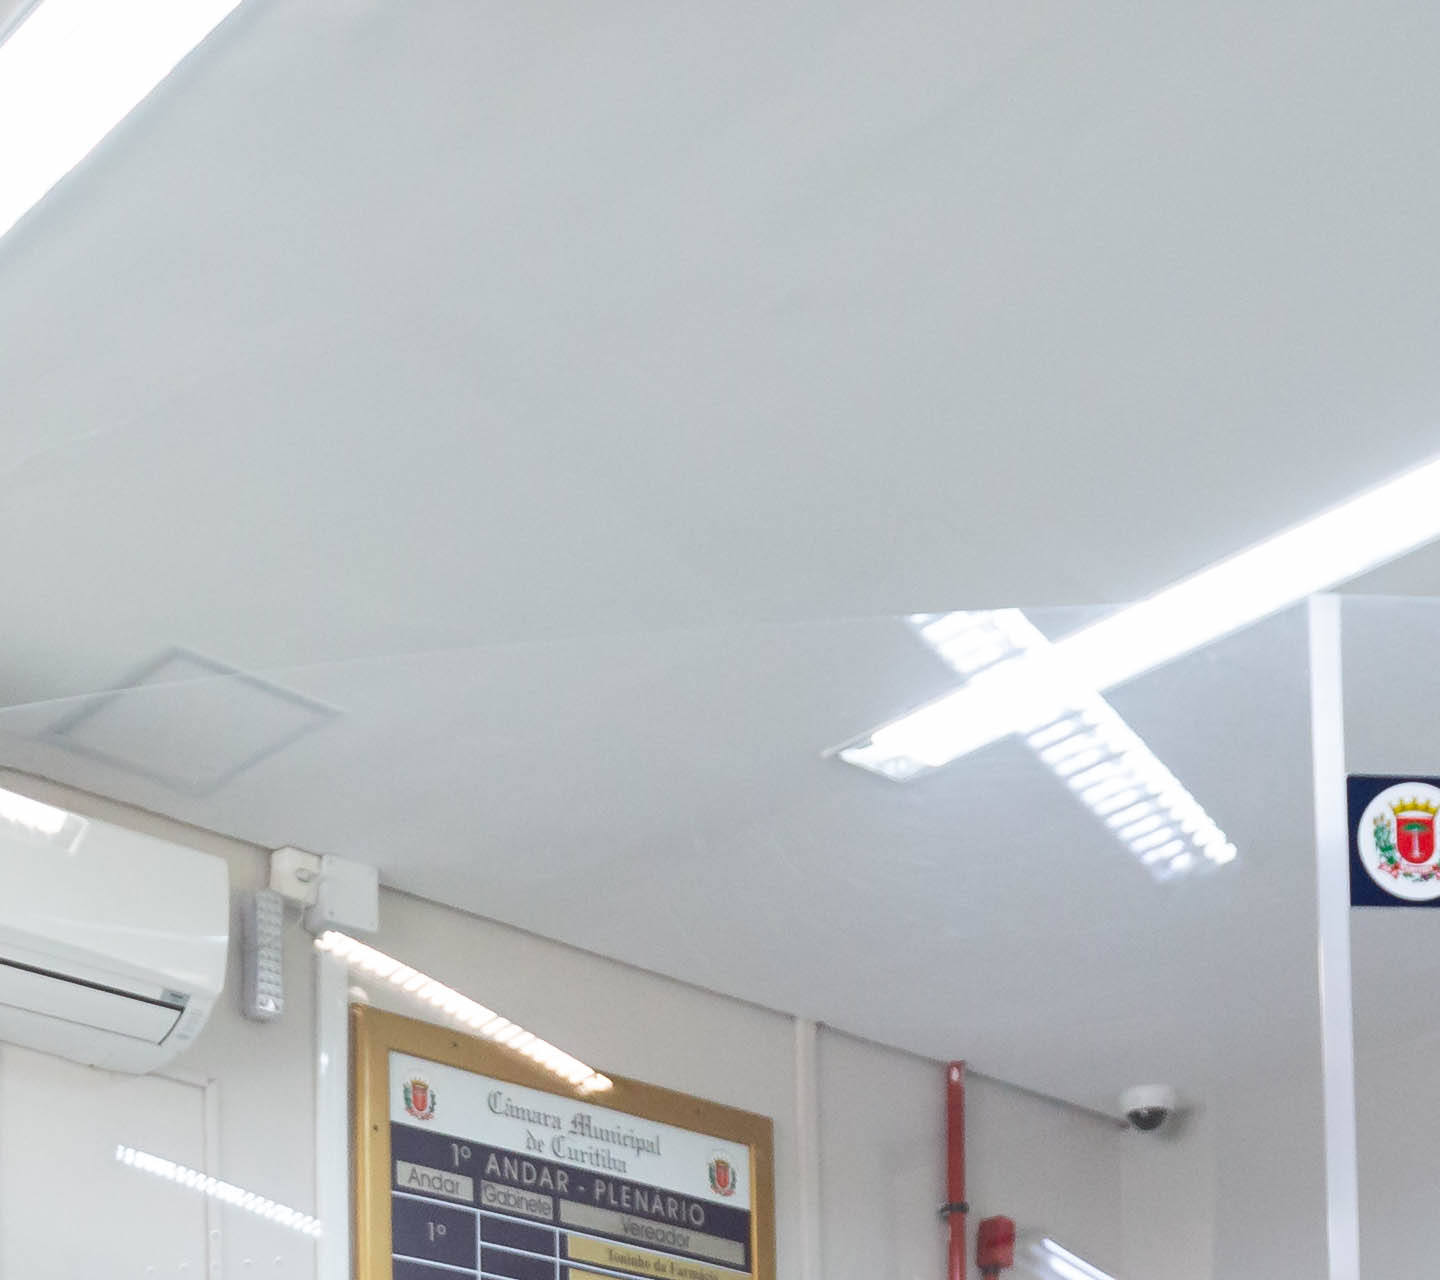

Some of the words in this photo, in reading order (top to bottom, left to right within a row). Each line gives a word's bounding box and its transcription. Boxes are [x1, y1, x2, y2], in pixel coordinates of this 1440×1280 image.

[487, 1090, 563, 1131] Câmara
[569, 1112, 662, 1159] Municipal
[525, 1130, 545, 1153] de
[551, 1136, 627, 1174] Curitiba
[407, 1169, 461, 1195] Andar
[483, 1183, 553, 1215] Gabinete
[485, 1153, 570, 1194] ANDAR
[594, 1178, 706, 1226] PLENÁRIO
[621, 1215, 691, 1249] Vereador
